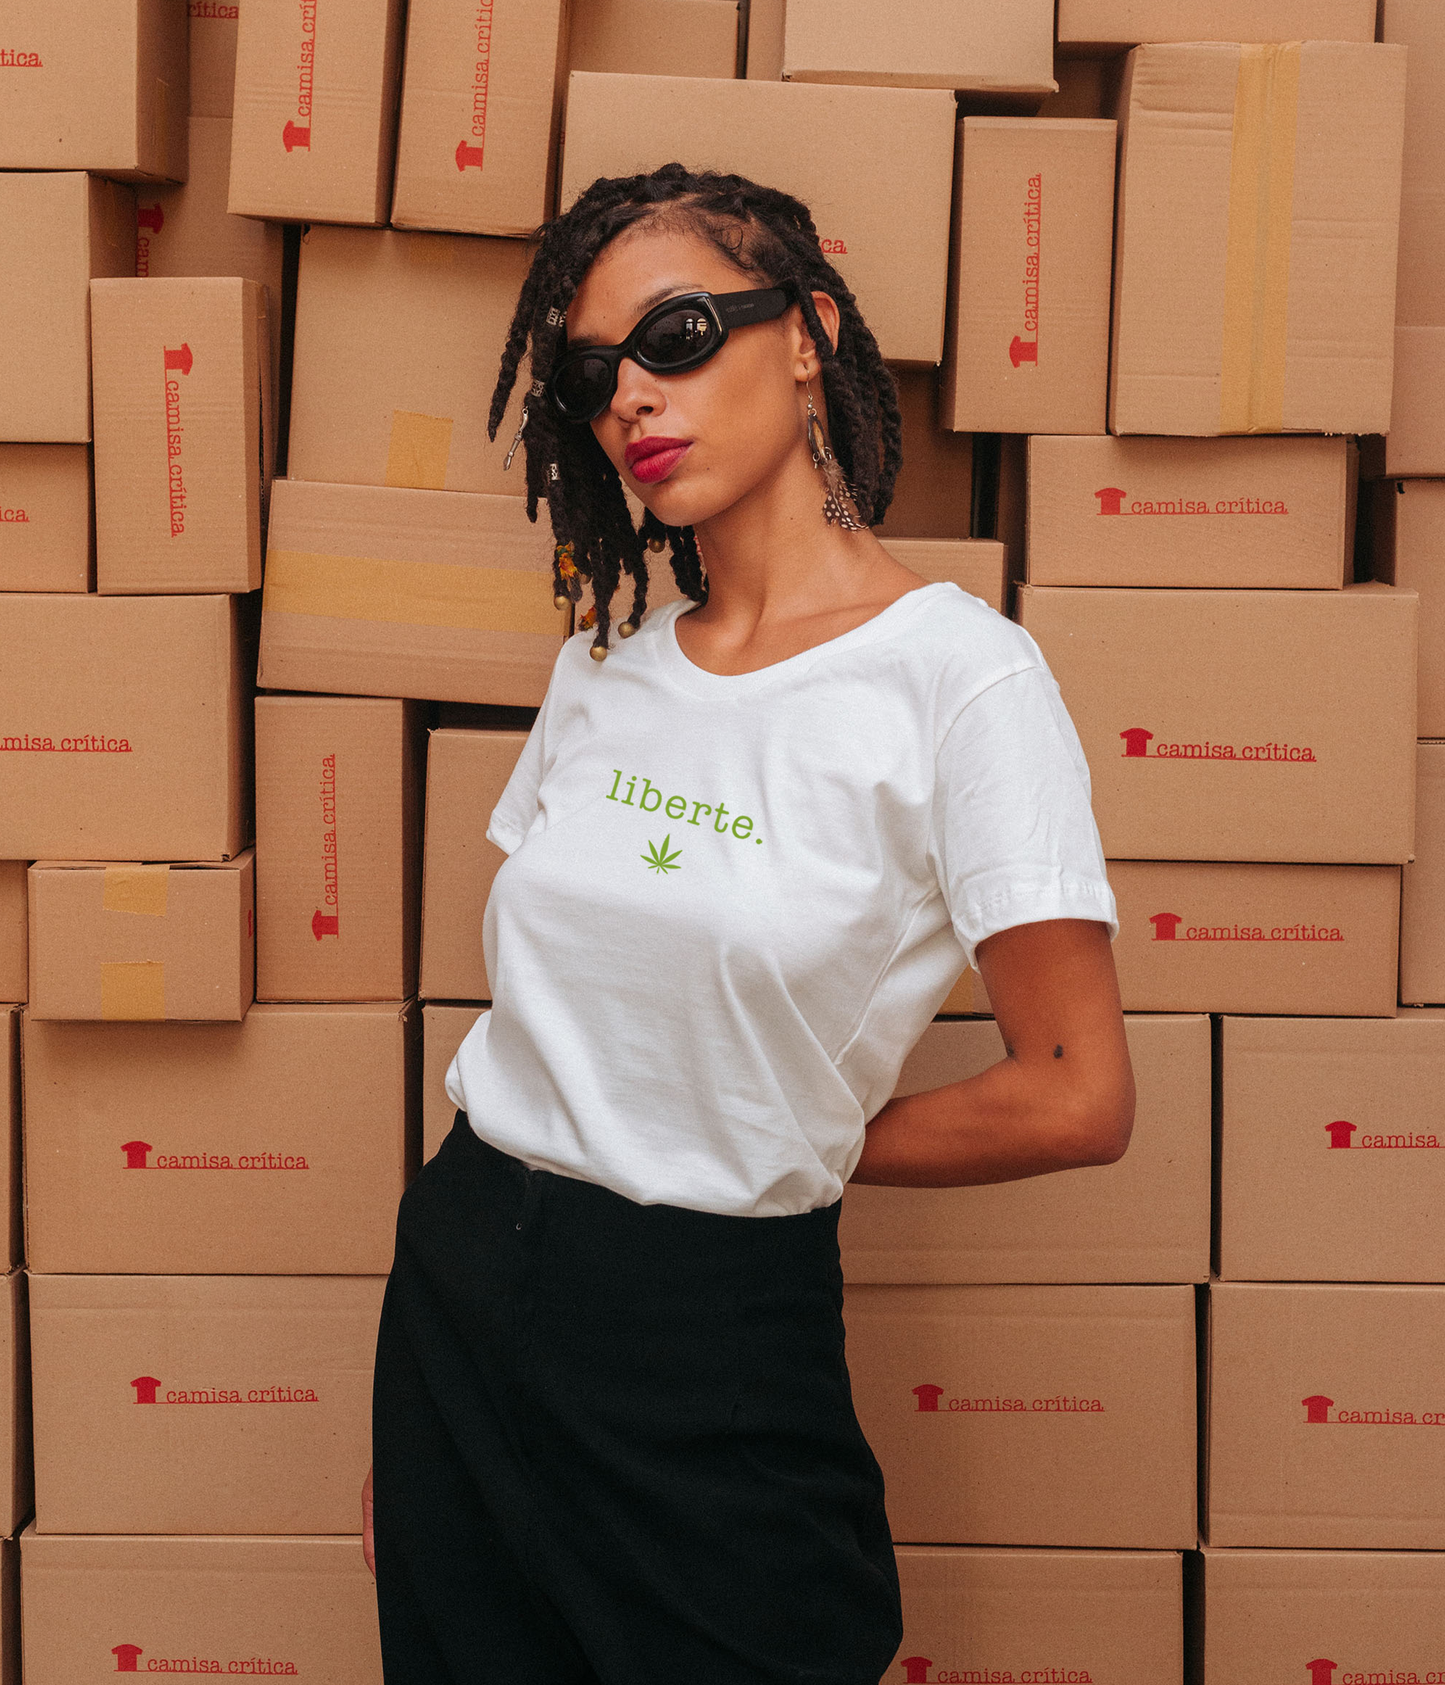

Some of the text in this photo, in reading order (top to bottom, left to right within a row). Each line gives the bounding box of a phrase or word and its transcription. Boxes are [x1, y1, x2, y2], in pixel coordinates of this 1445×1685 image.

[187, 1, 239, 19] rítica
[0, 49, 43, 67] tica
[296, 38, 316, 117] camisa
[471, 0, 494, 137] camisa crític
[1022, 173, 1042, 331] camisa crítica
[164, 379, 187, 538] camisa crítica
[1131, 498, 1288, 515] camisa crítica
[0, 734, 133, 753] misa crítica
[1157, 742, 1317, 762] camisa crítica
[606, 770, 762, 844] liberte.
[320, 754, 338, 905] camisa crítica
[1186, 924, 1344, 942] camisa crítica
[1360, 1132, 1440, 1149] camisa
[156, 1152, 309, 1170] camisa crítica
[166, 1386, 319, 1405] camisa crítica
[949, 1396, 1104, 1412] camisa crítica
[1338, 1408, 1417, 1425] camisa
[147, 1657, 298, 1675] camisa crítica
[938, 1668, 1092, 1684] camisa crítica
[1343, 1669, 1420, 1685] camisa
